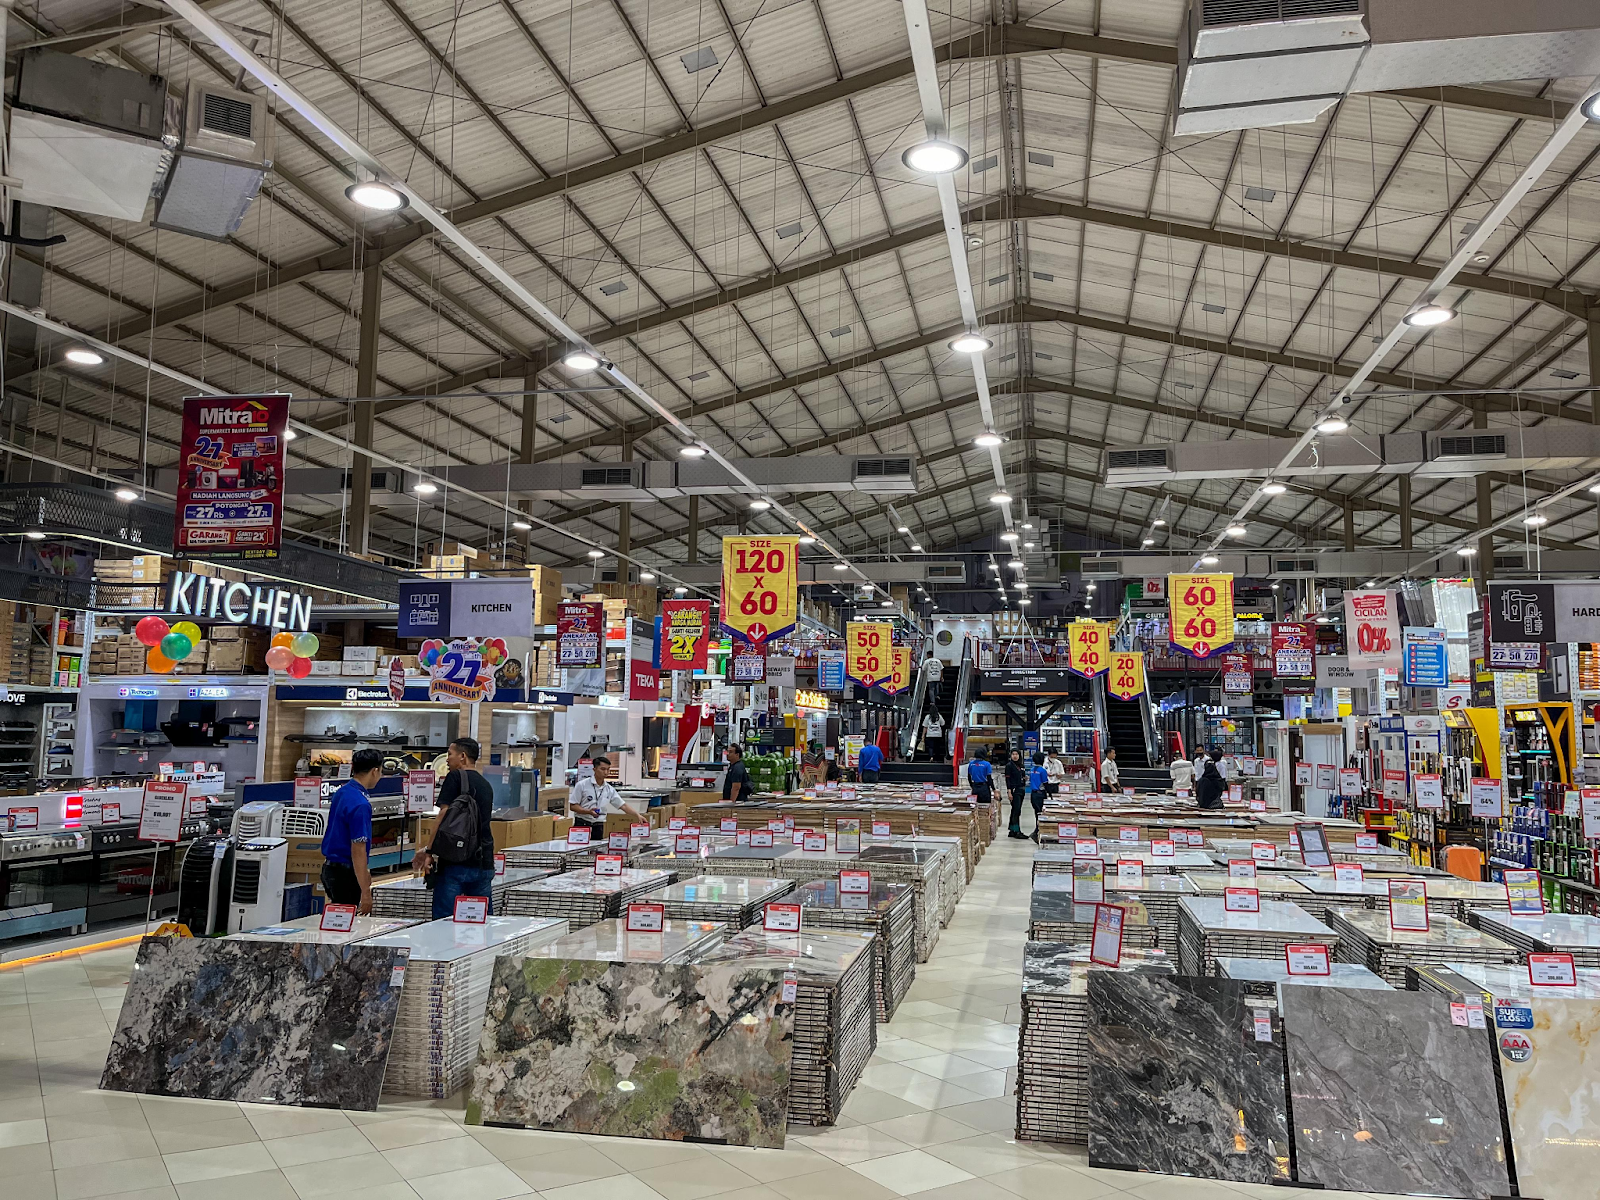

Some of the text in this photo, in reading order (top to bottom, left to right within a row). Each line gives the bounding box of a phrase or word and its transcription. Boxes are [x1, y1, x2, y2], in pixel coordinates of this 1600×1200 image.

[200, 408, 269, 425] Mitra10
[195, 437, 223, 459] 27
[196, 507, 214, 518] 27
[247, 506, 263, 517] 27
[750, 540, 772, 548] SIZE
[736, 549, 784, 574] 120
[171, 571, 313, 632] KITCHEN
[1183, 586, 1216, 606] 60
[471, 603, 512, 613] KITCHEN
[740, 591, 778, 615] 60
[1354, 608, 1387, 616] CICILAN
[1184, 618, 1216, 638] 60
[857, 632, 880, 647] 50
[1078, 632, 1098, 644] 40
[1357, 623, 1391, 653] 0%
[1079, 652, 1099, 665] 40
[1524, 652, 1538, 660] 270
[442, 652, 481, 687] 27
[856, 657, 879, 672] 50
[1117, 658, 1134, 670] 20
[635, 673, 655, 688] TEKA
[1117, 677, 1135, 688] 40
[358, 690, 388, 698] Electrolux
[433, 682, 481, 699] ANNIVERSARY
[5, 693, 26, 703] OVE
[414, 795, 428, 803] 50%
[1497, 998, 1511, 1006] X4
[1499, 1008, 1528, 1016] SUPER
[1502, 1039, 1530, 1049] AAA
